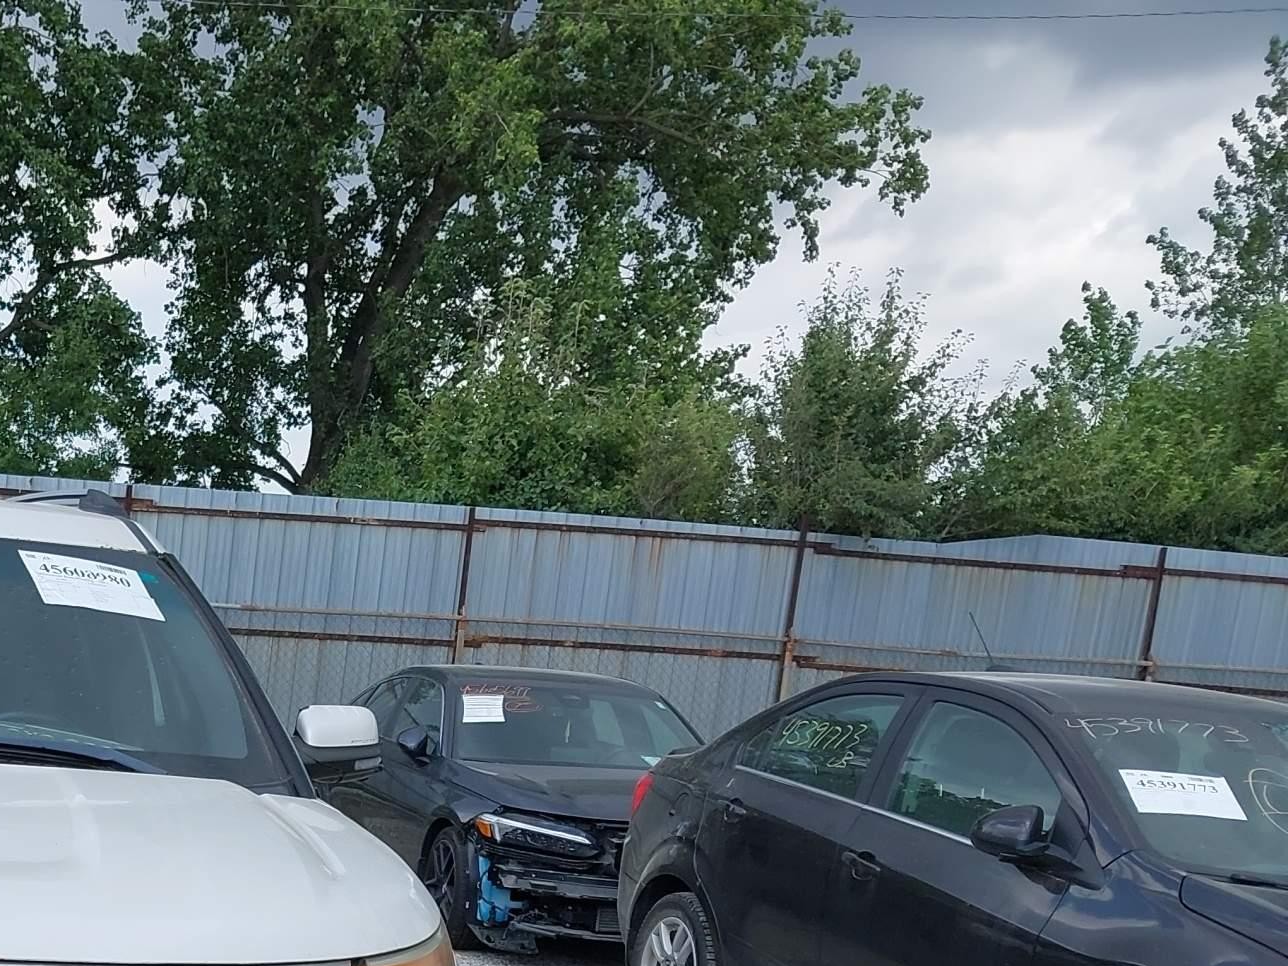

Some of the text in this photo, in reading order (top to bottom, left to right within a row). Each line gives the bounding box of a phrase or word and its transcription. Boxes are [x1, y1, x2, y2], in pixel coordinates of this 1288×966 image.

[778, 719, 868, 750] 45391773
[1064, 718, 1249, 743] 45391773
[1136, 779, 1219, 794] 45391773
